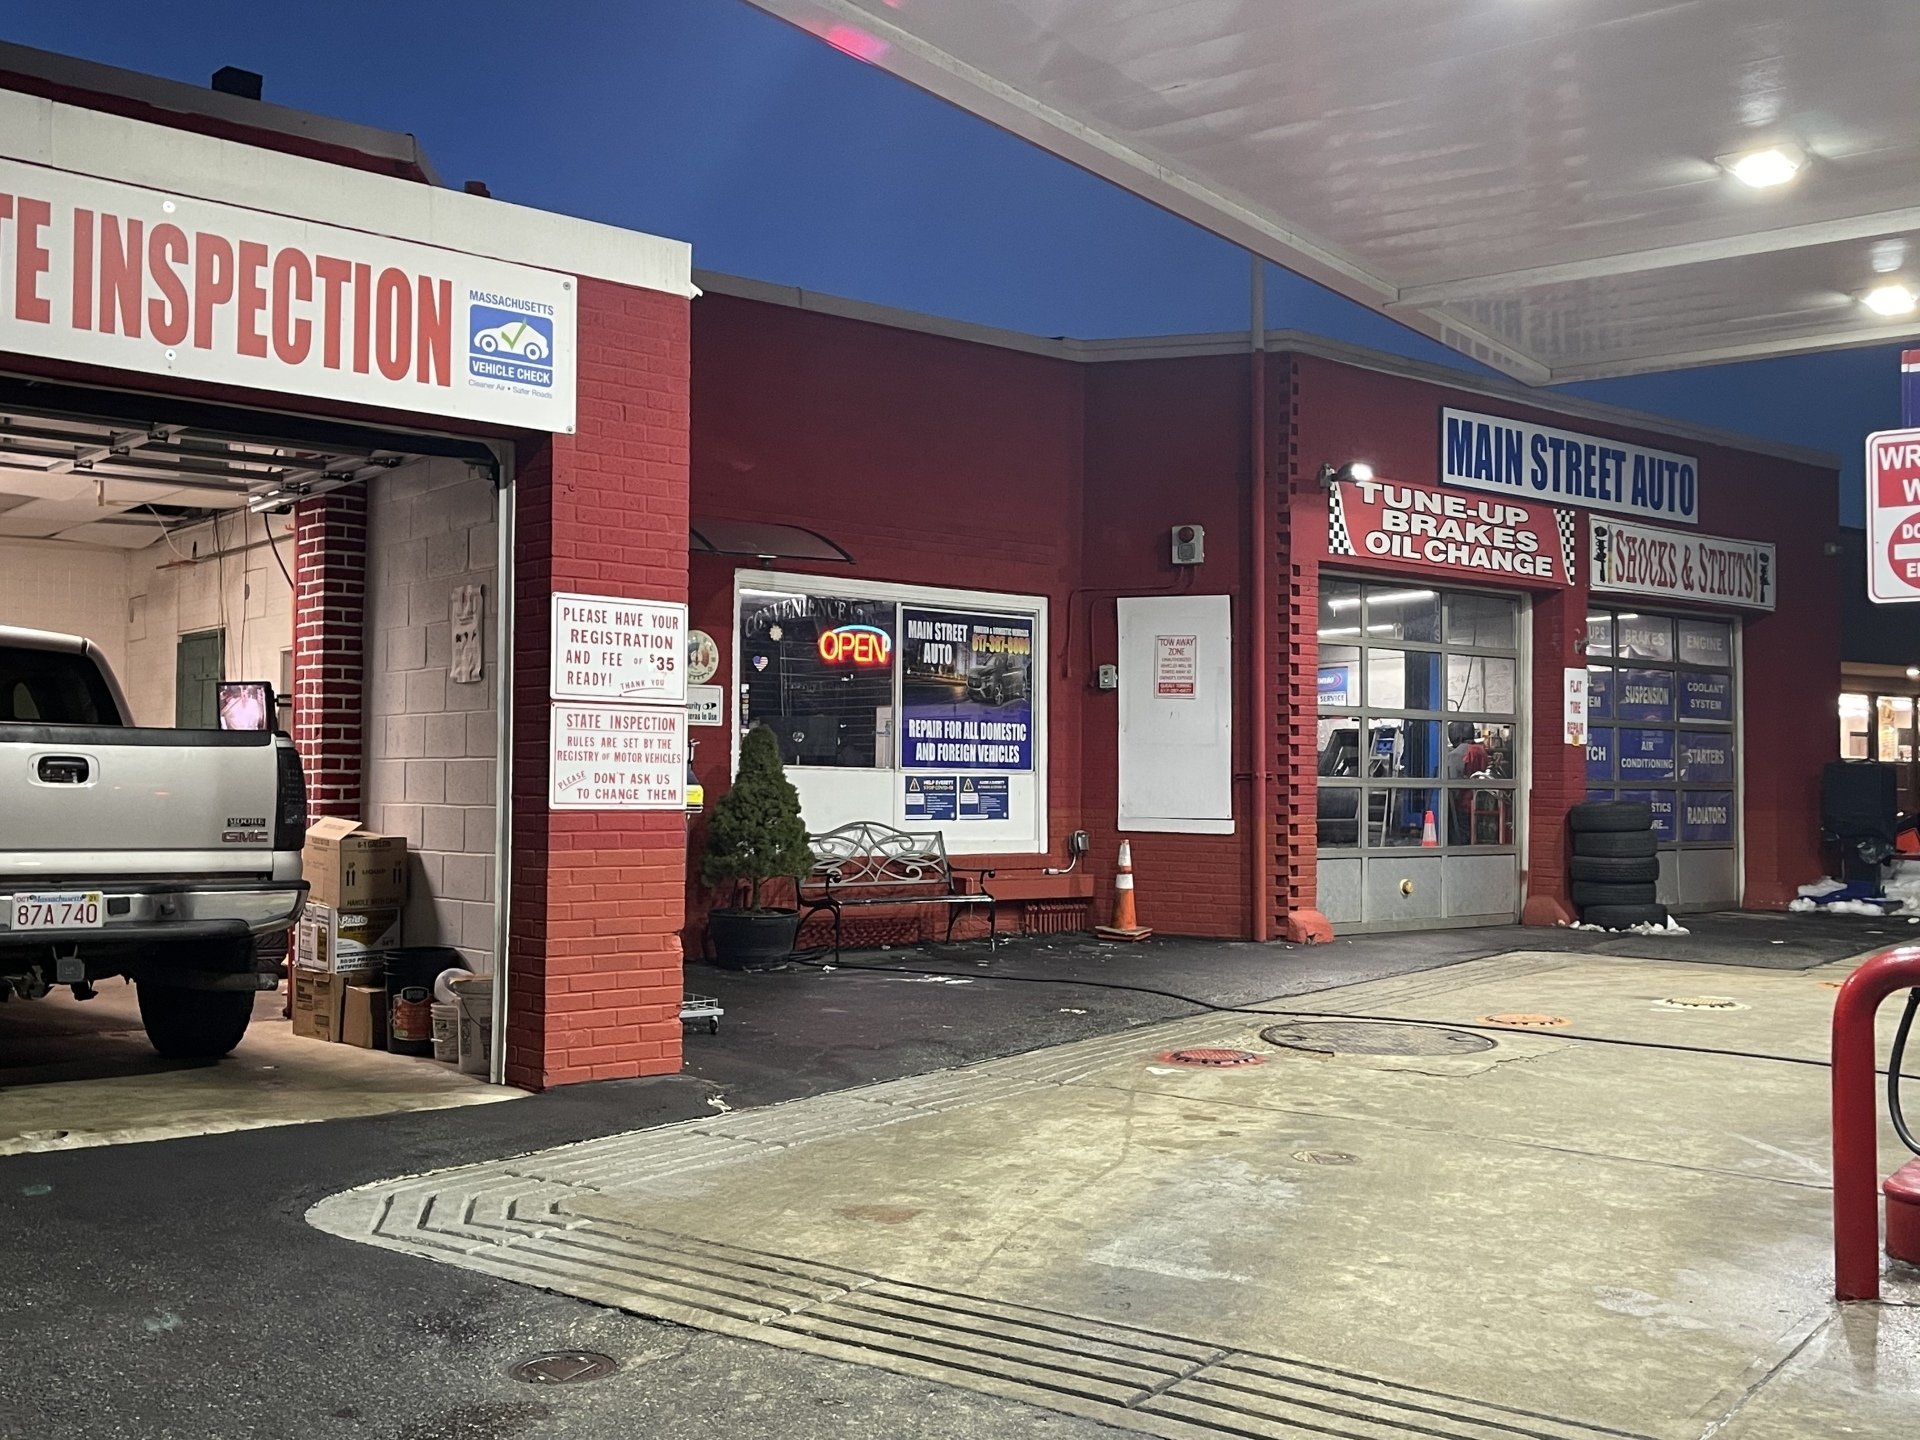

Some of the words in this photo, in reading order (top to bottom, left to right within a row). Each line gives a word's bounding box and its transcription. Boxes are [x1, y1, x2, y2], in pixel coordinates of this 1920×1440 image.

[72, 207, 452, 387] INSPECTION
[469, 290, 554, 316] MASSACHUSETTS
[472, 361, 515, 378] VEHICLE
[517, 368, 551, 384] CHECK
[468, 379, 494, 390] Cleaner
[496, 383, 505, 391] Air
[512, 386, 530, 395] Safer
[532, 389, 553, 399] Roads
[1447, 417, 1523, 487] MAIN
[1531, 433, 1627, 503] STREET
[1631, 453, 1695, 516] AUTO
[1356, 482, 1529, 527] TUNE-UP
[1382, 509, 1539, 553] BRAKES
[1365, 531, 1422, 560] OIL
[1423, 539, 1553, 577] CHANGE
[1615, 529, 1677, 589] SHOCKS
[1681, 545, 1695, 591] &
[1699, 543, 1752, 599] STRUTS
[563, 607, 607, 624] PLEASE
[615, 611, 643, 627] HAVE
[651, 614, 679, 630] YOUR
[570, 628, 673, 650] REGISTRATION
[908, 620, 933, 640] MAIN
[934, 622, 968, 643] STREET
[1625, 629, 1665, 646] BRAKES
[1687, 635, 1722, 651] ENGINE
[820, 631, 887, 663] OPEN
[1160, 638, 1175, 646] TOW
[1176, 638, 1194, 646] AWAY
[1168, 648, 1185, 656] ZONE
[565, 649, 591, 665] AND
[602, 652, 623, 667] FEE
[633, 657, 643, 665] OF
[649, 654, 675, 671] $35
[923, 643, 952, 665] AUTO
[567, 670, 612, 687] READY!
[620, 680, 645, 690] THANK
[651, 679, 665, 687] YOU
[1570, 681, 1582, 693] FLAT
[1687, 682, 1724, 694] COOLANT
[1625, 685, 1669, 705] SUSPENSION
[1690, 699, 1721, 710] SYSTEM
[1570, 701, 1581, 714] TIRE
[566, 713, 601, 729] STATE
[610, 715, 676, 731] INSPECTION
[909, 719, 943, 739] REPAIR
[944, 721, 962, 739] FOR
[963, 721, 979, 740] ALL
[980, 722, 1026, 741] DOMESTIC
[1567, 722, 1584, 735] REPAIR
[567, 736, 595, 747] RULES
[601, 737, 617, 748] ARE
[623, 738, 638, 748] SET
[643, 738, 654, 749] BY
[657, 739, 672, 750] THE
[915, 742, 935, 761] AND
[937, 743, 976, 762] FOREIGN
[978, 744, 1020, 763] VEHICLES
[1641, 741, 1654, 751] AIR
[557, 750, 599, 761] REGISTRY
[614, 752, 643, 763] MOTOR
[645, 753, 681, 764] VEHICLES
[1621, 758, 1674, 769] CONDITIONING
[1688, 748, 1725, 764] STARTERS
[557, 770, 586, 790] PLEASE
[594, 772, 625, 784] DON'T
[631, 773, 651, 785] ASK
[656, 774, 670, 785] US
[577, 788, 589, 800] TO
[595, 788, 639, 800] CHANGE
[647, 789, 677, 800] THEM
[1687, 807, 1727, 825] RADIATORS
[222, 832, 268, 843] GMC
[18, 904, 54, 925] 87A
[61, 903, 97, 924] 740
